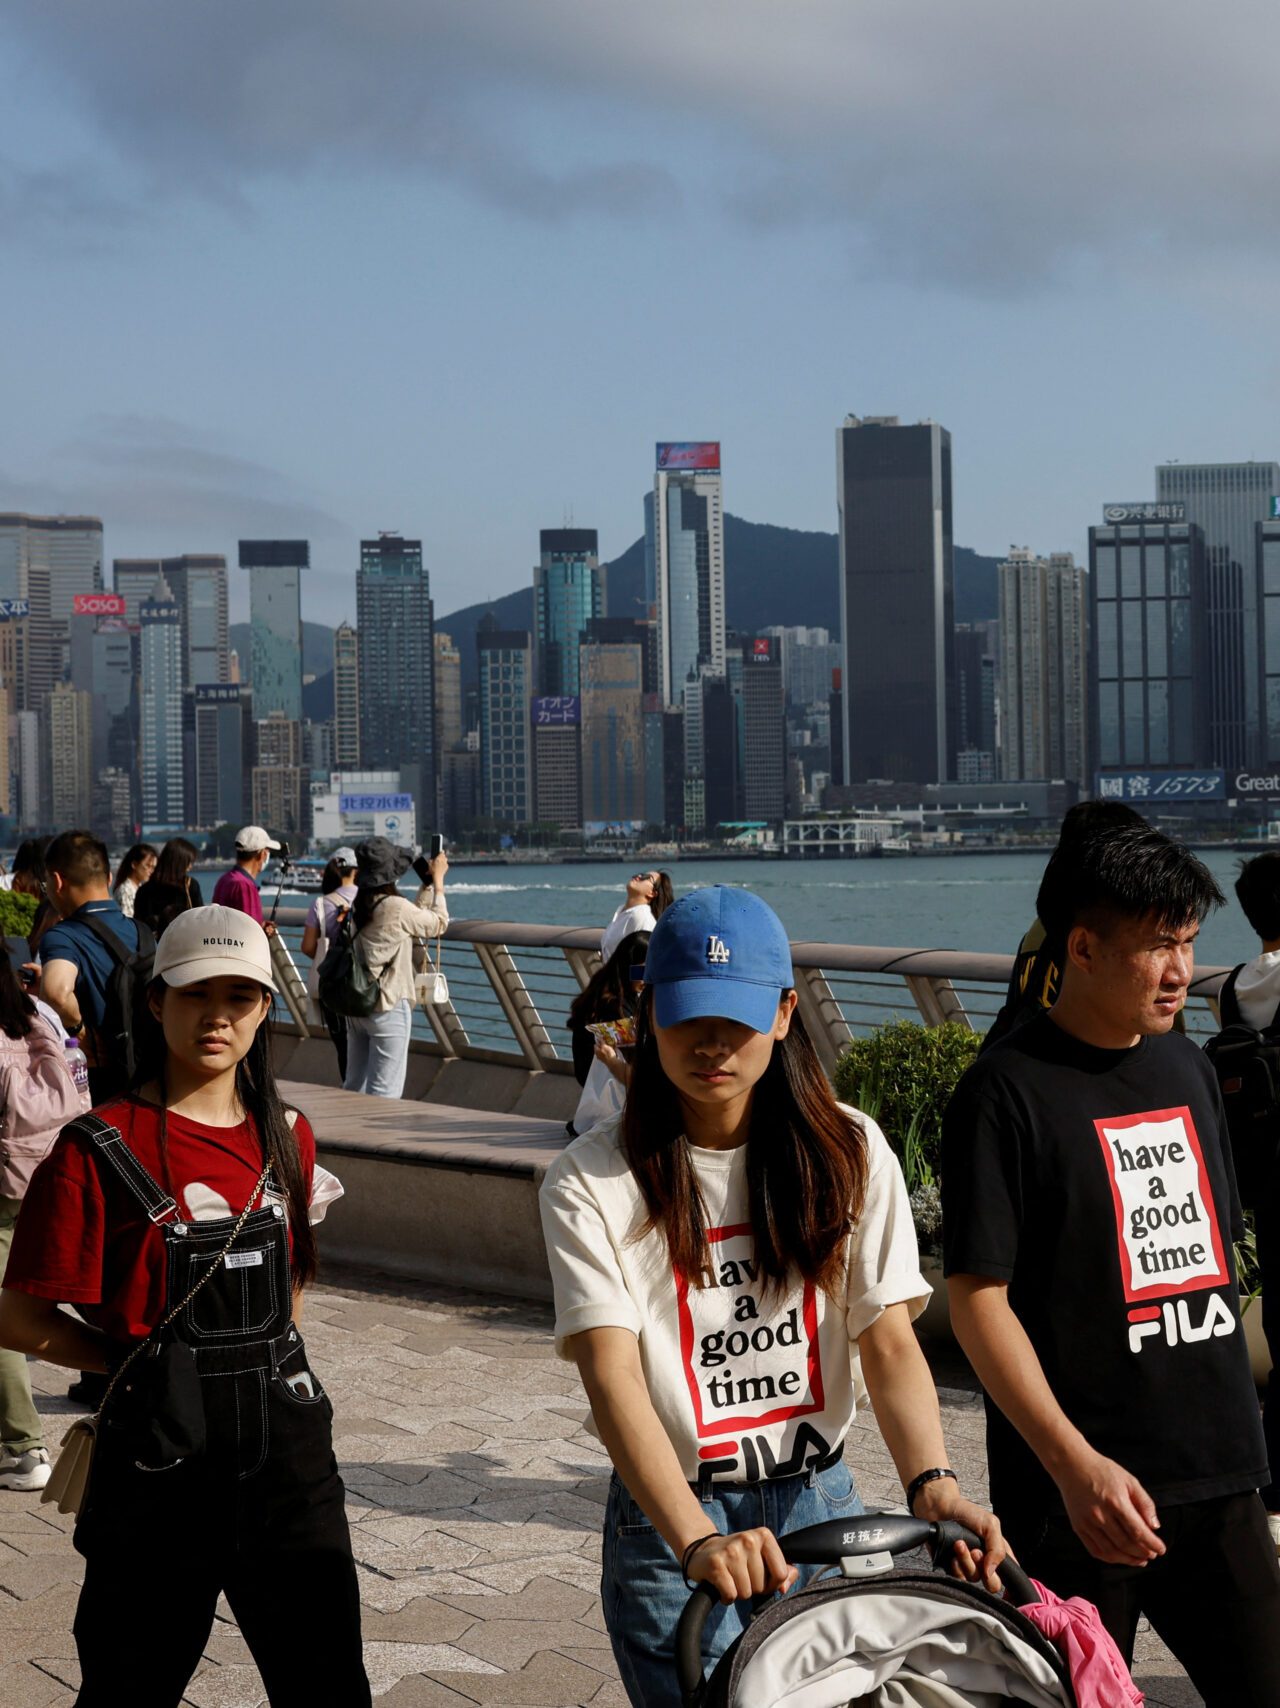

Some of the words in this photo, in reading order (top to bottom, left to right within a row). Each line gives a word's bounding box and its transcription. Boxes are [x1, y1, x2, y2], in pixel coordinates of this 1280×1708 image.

[538, 696, 575, 709] イオン
[538, 710, 575, 723] カード
[1235, 773, 1280, 792] Great
[203, 937, 244, 948] HOLIDAY
[708, 935, 730, 963] LA
[1113, 1139, 1186, 1172] have
[1148, 1176, 1167, 1199] a
[1130, 1192, 1201, 1239] good
[1137, 1241, 1206, 1275] time
[734, 1294, 759, 1322] a
[1127, 1293, 1236, 1353] FILA
[700, 1308, 802, 1367] good
[706, 1369, 801, 1408] time
[697, 1421, 832, 1482] FILA
[842, 1528, 884, 1545] 好孩子
